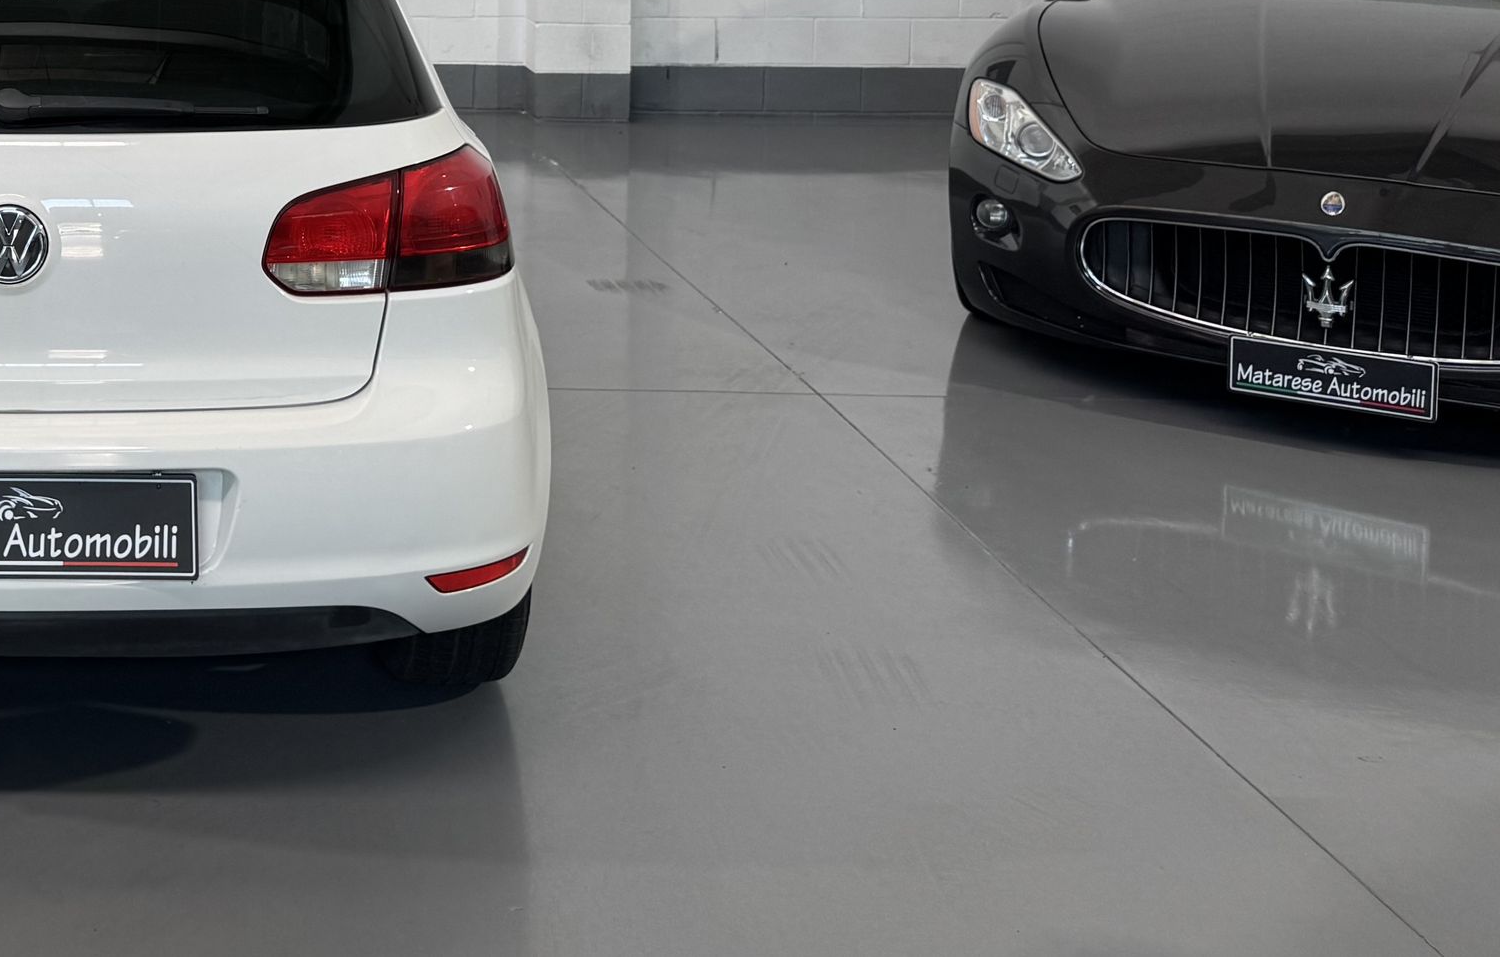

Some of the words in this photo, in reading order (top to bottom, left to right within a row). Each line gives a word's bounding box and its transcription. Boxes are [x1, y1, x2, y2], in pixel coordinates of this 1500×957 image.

[1236, 362, 1323, 393] Matarese
[1327, 376, 1426, 409] Automobili
[2, 523, 178, 559] Automobili
